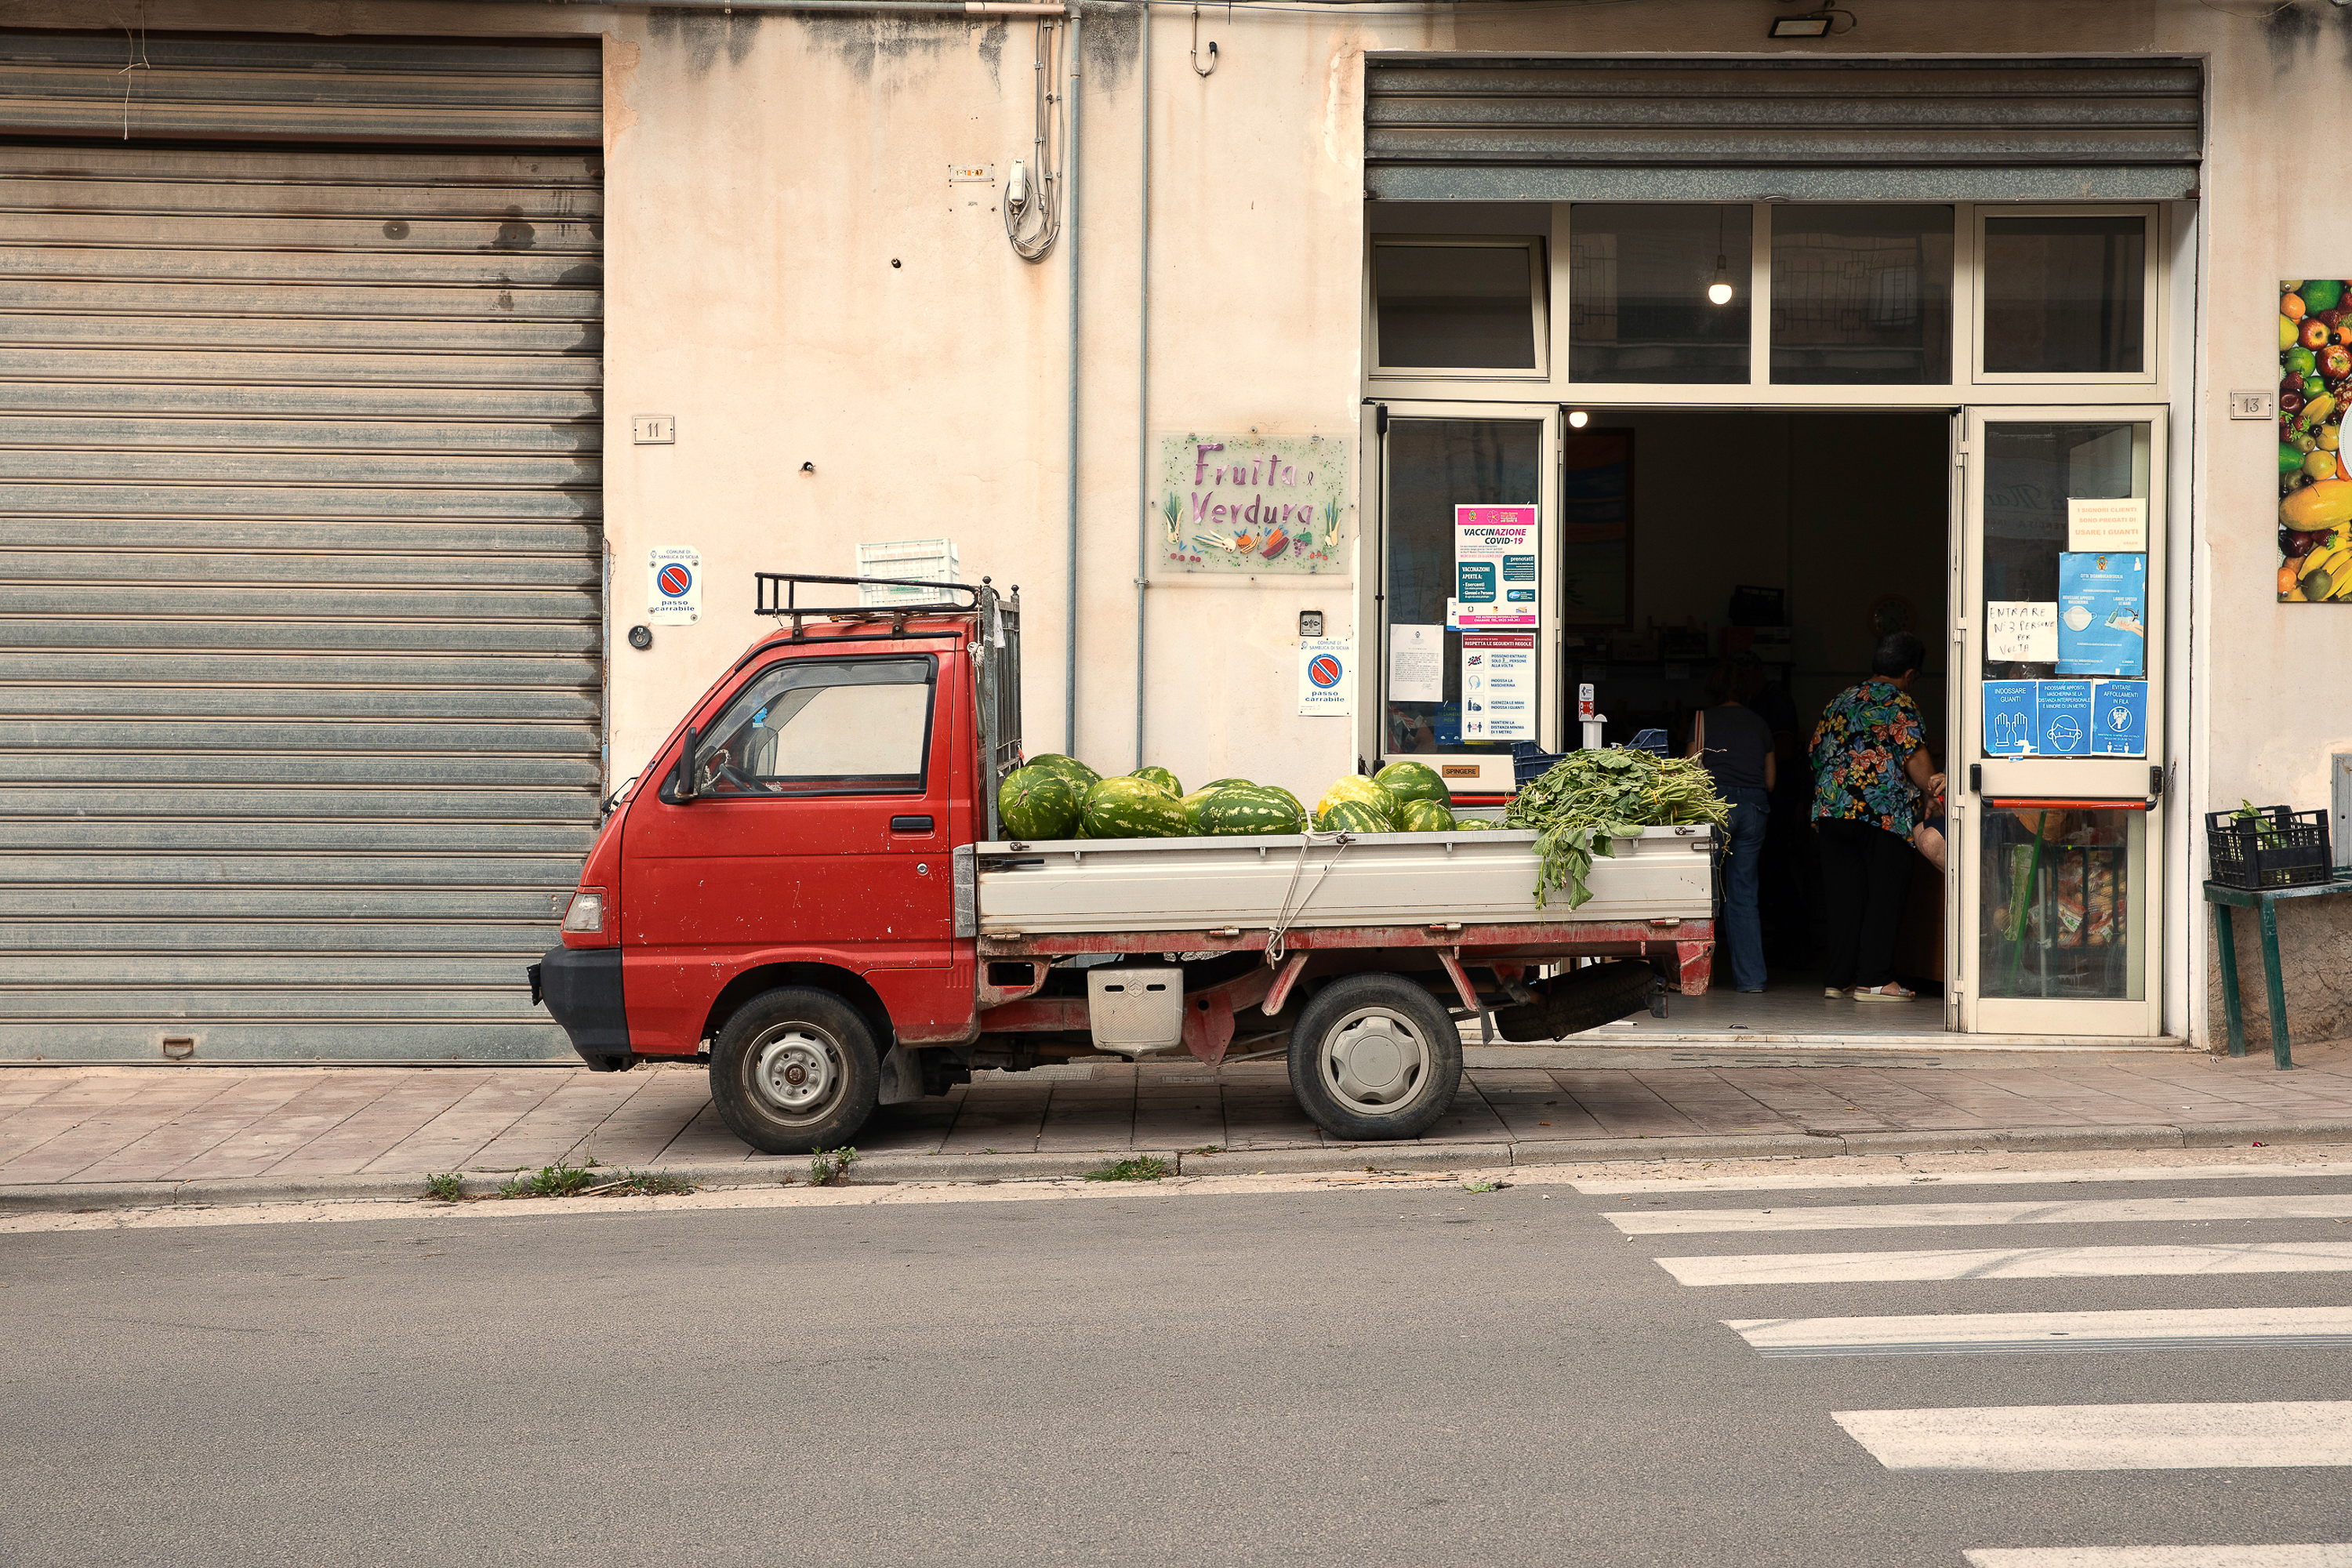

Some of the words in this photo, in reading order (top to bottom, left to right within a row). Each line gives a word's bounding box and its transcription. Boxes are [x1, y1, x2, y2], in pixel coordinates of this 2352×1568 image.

[2243, 398, 2259, 412] 13
[647, 423, 658, 437] 11
[1195, 443, 1296, 486] Frutta
[1191, 491, 1313, 524] Verdura
[1990, 608, 2045, 619] ENTRARE
[2009, 621, 2015, 633] 3
[2020, 620, 2055, 631] PERSONE
[2000, 644, 2029, 655] VOLTA
